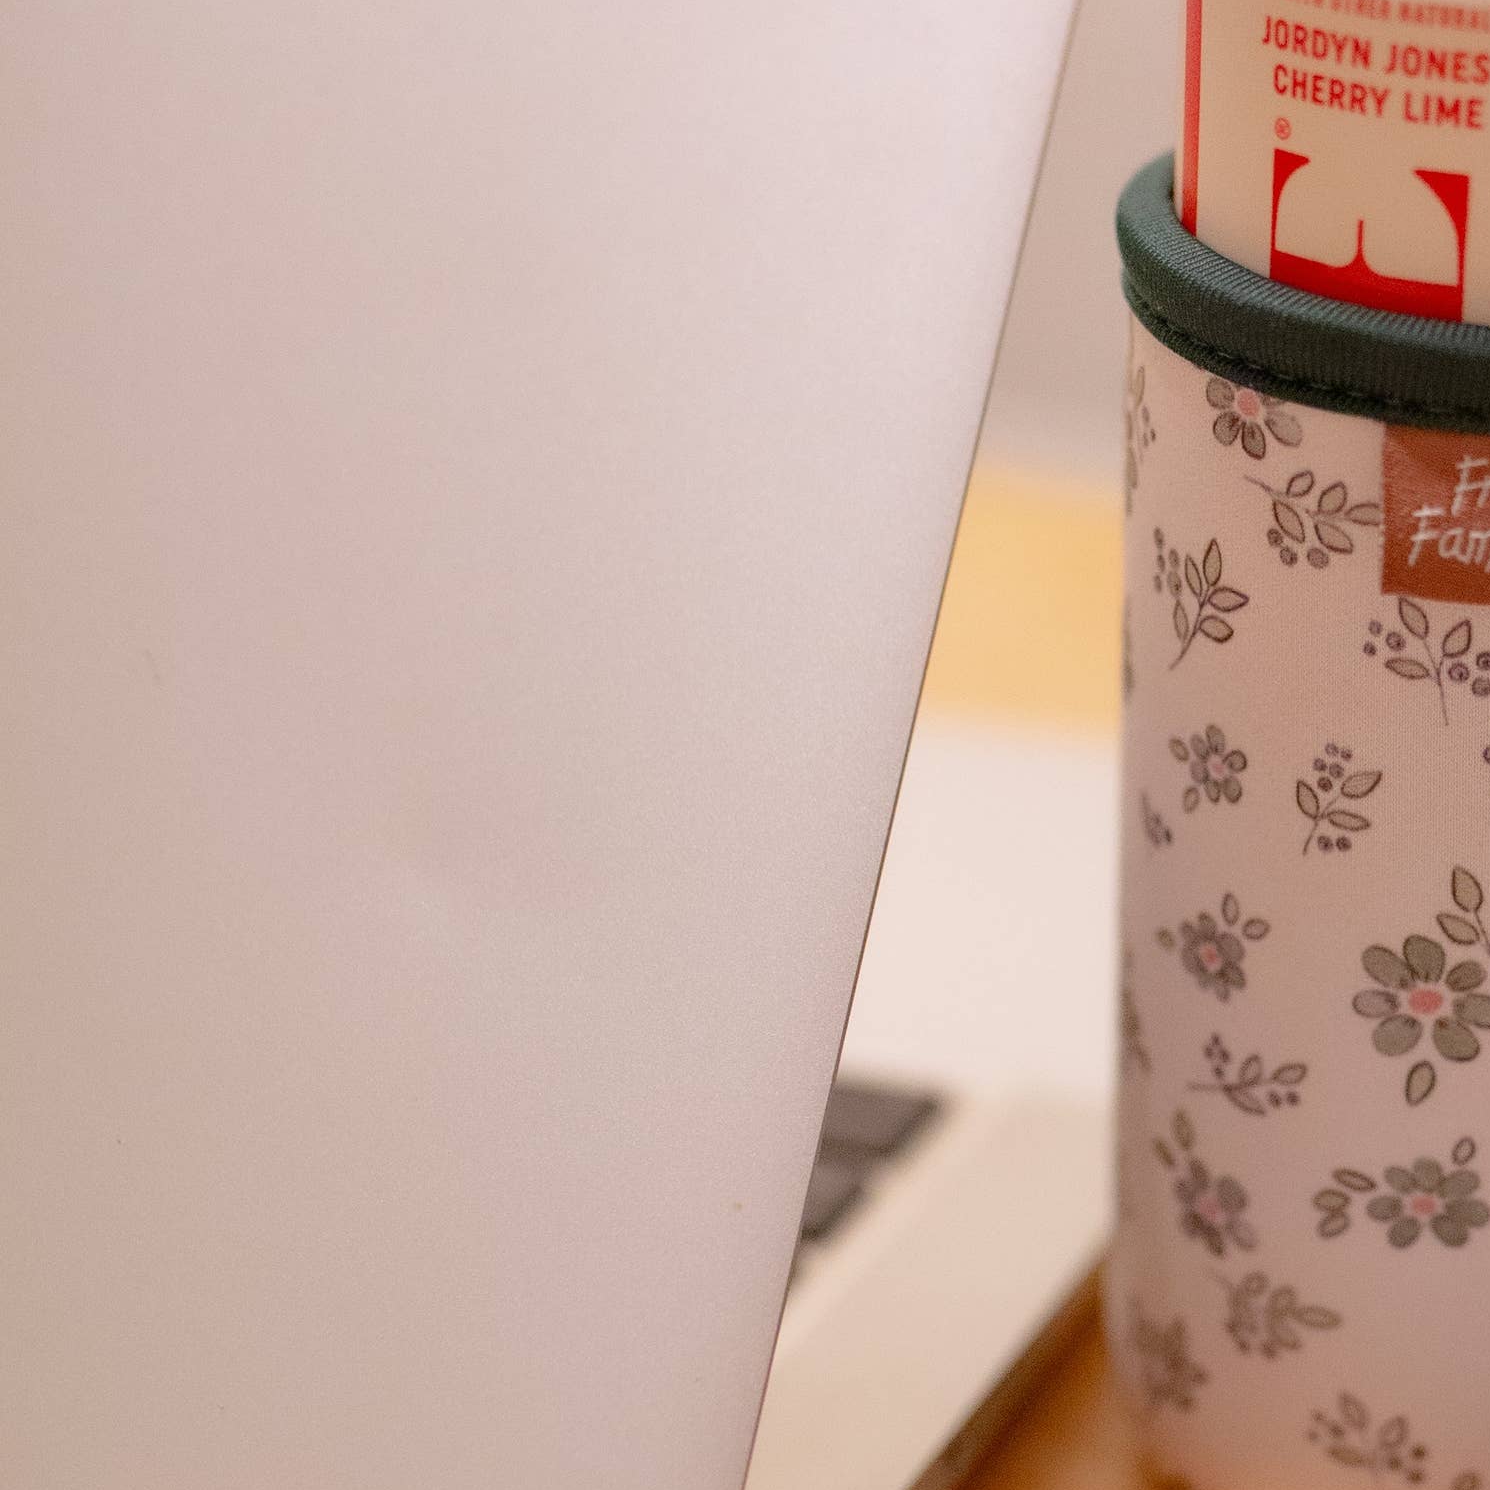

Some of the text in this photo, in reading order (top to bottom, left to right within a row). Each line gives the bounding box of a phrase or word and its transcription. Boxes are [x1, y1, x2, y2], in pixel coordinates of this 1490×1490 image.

[1262, 15, 1372, 69] JORDYN
[1273, 63, 1484, 130] CHERRY LIME
